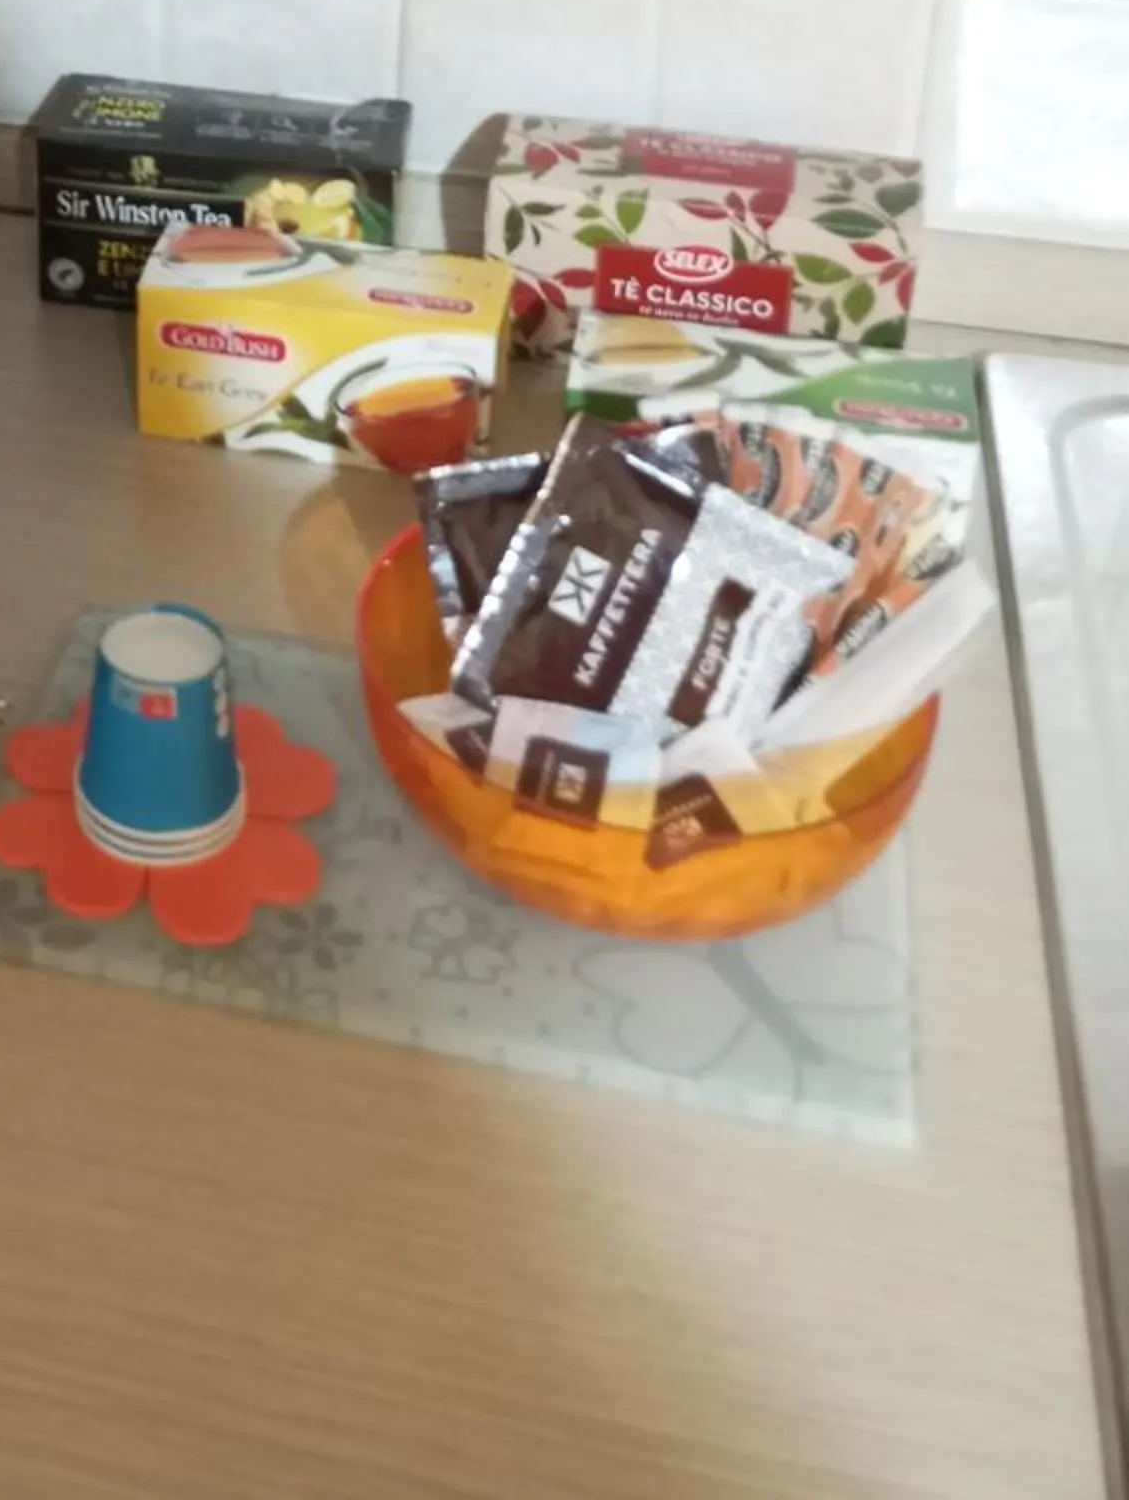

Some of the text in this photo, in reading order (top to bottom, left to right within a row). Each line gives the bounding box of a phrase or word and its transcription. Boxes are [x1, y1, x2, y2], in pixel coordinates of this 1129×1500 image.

[55, 189, 232, 228] Sir Winston Tea
[662, 249, 726, 274] SELEX
[646, 284, 774, 319] CLASSICO
[574, 528, 663, 689] KAFFETTERA
[691, 616, 731, 691] FORTE
